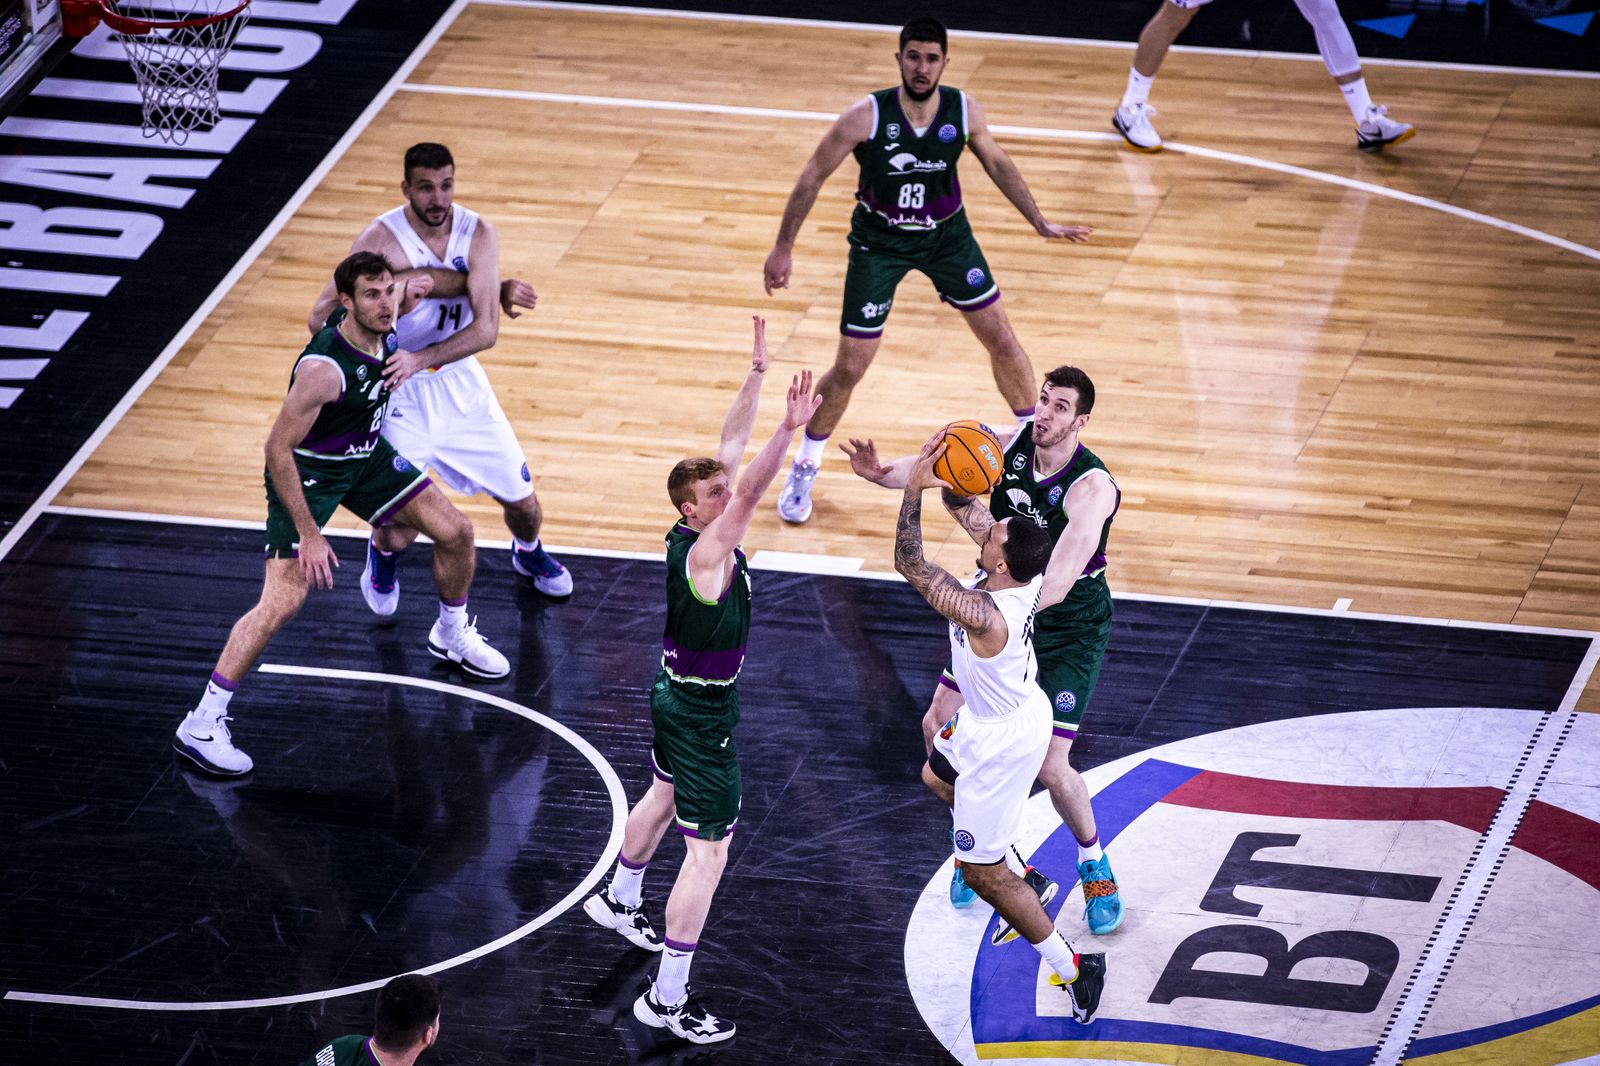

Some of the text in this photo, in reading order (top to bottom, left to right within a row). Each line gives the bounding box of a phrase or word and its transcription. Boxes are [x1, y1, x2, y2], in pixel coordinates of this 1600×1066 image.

[898, 183, 926, 209] 83
[437, 304, 462, 330] 14
[1147, 831, 1443, 1014] BT
